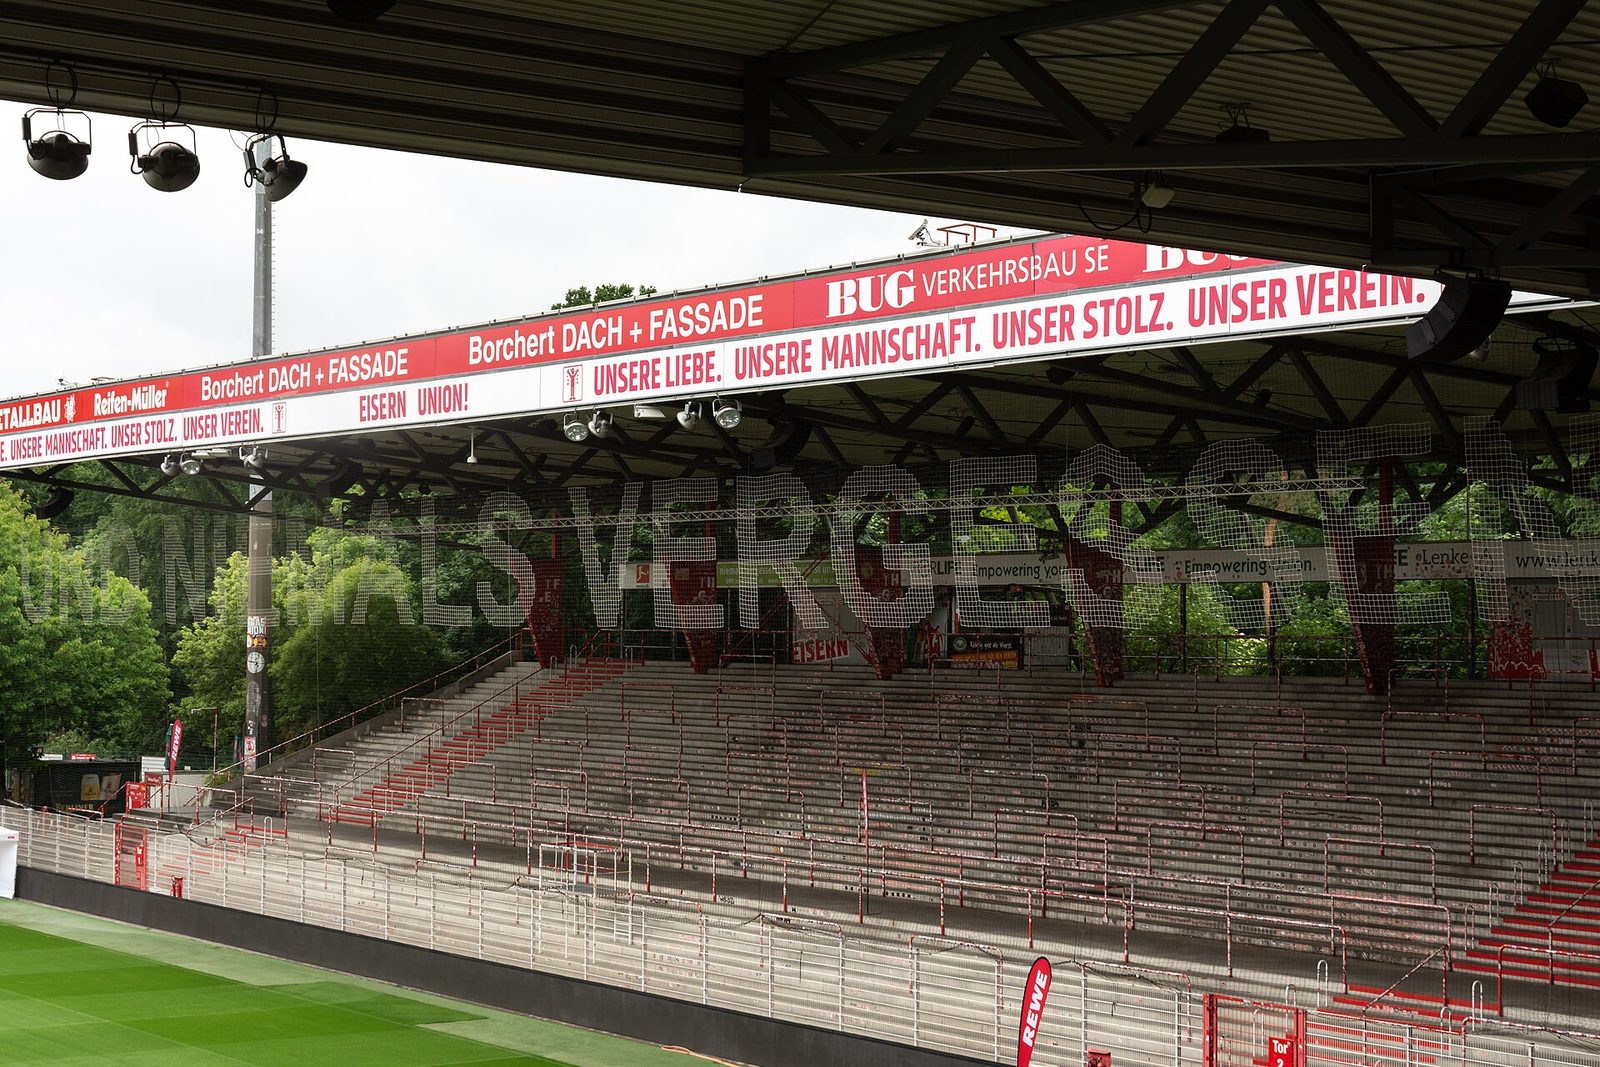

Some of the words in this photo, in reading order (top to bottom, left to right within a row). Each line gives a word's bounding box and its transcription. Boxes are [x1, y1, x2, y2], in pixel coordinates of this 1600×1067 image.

[826, 268, 916, 318] BUG
[922, 248, 1078, 297] VERKEHRSBAU
[1085, 244, 1109, 273] SE
[469, 325, 555, 365] Borchert
[562, 315, 622, 352] DACH
[649, 294, 763, 342] FASSADE
[594, 358, 661, 396] UNSERE
[666, 351, 721, 387] LIEBE.
[735, 339, 812, 381] UNSERE
[821, 316, 981, 370] MANNSCHAFT.
[993, 304, 1075, 350] UNSER
[1083, 292, 1173, 340] STOLZ.
[1188, 278, 1287, 327] UNSER
[1296, 269, 1425, 317] VEREIN.
[202, 371, 264, 401] Borchert
[269, 363, 310, 393] DACH
[328, 348, 408, 384] FASSADE
[94, 387, 167, 417] Reifen-Müller
[359, 394, 406, 422] EISERN
[418, 383, 468, 416] UNION!
[11, 436, 42, 460] UNSERE
[45, 427, 108, 456] MANNSCHAFT.
[111, 422, 142, 448] UNSER
[144, 418, 177, 446] STOLZ.
[183, 414, 217, 442] UNSER
[221, 409, 264, 436] VEREIN.
[1515, 551, 1600, 568] www.lenk
[792, 639, 849, 664] EISERN
[1022, 969, 1049, 1048] REWE
[1272, 1040, 1288, 1055] Tor
